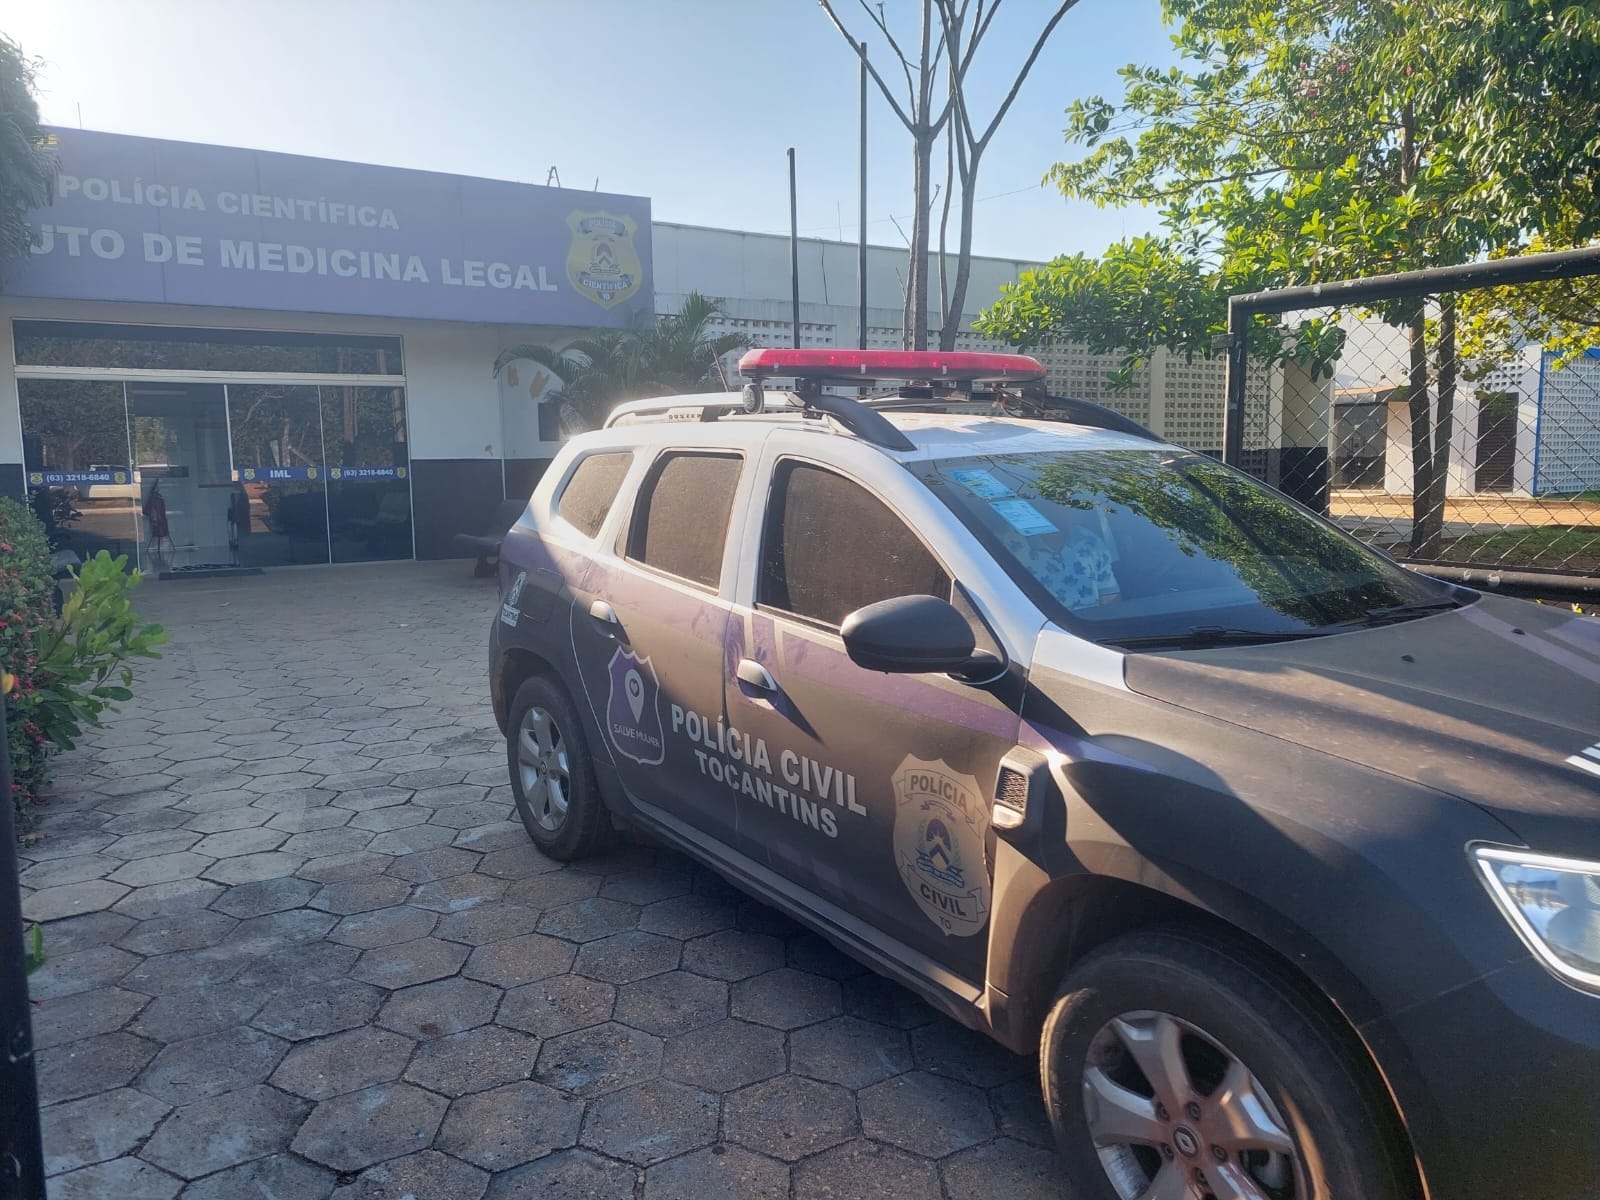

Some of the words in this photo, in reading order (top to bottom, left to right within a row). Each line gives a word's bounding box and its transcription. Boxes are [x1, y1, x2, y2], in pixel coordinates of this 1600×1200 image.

[58, 174, 206, 211] POLÍCIA
[217, 192, 399, 230] CIENTÍFICA
[143, 232, 204, 265] DE
[220, 239, 429, 283] MEDICINA
[441, 258, 558, 291] LEGAL
[46, 473, 64, 483] (63)
[270, 469, 292, 478] IML
[613, 723, 636, 738] SALVE
[671, 704, 774, 775] POLÍCIA
[780, 749, 867, 816] CIVIL
[694, 748, 838, 838] TOCANTINS
[910, 774, 968, 812] POLÍCIA
[919, 883, 967, 917] CIVIL
[938, 914, 952, 930] TO
